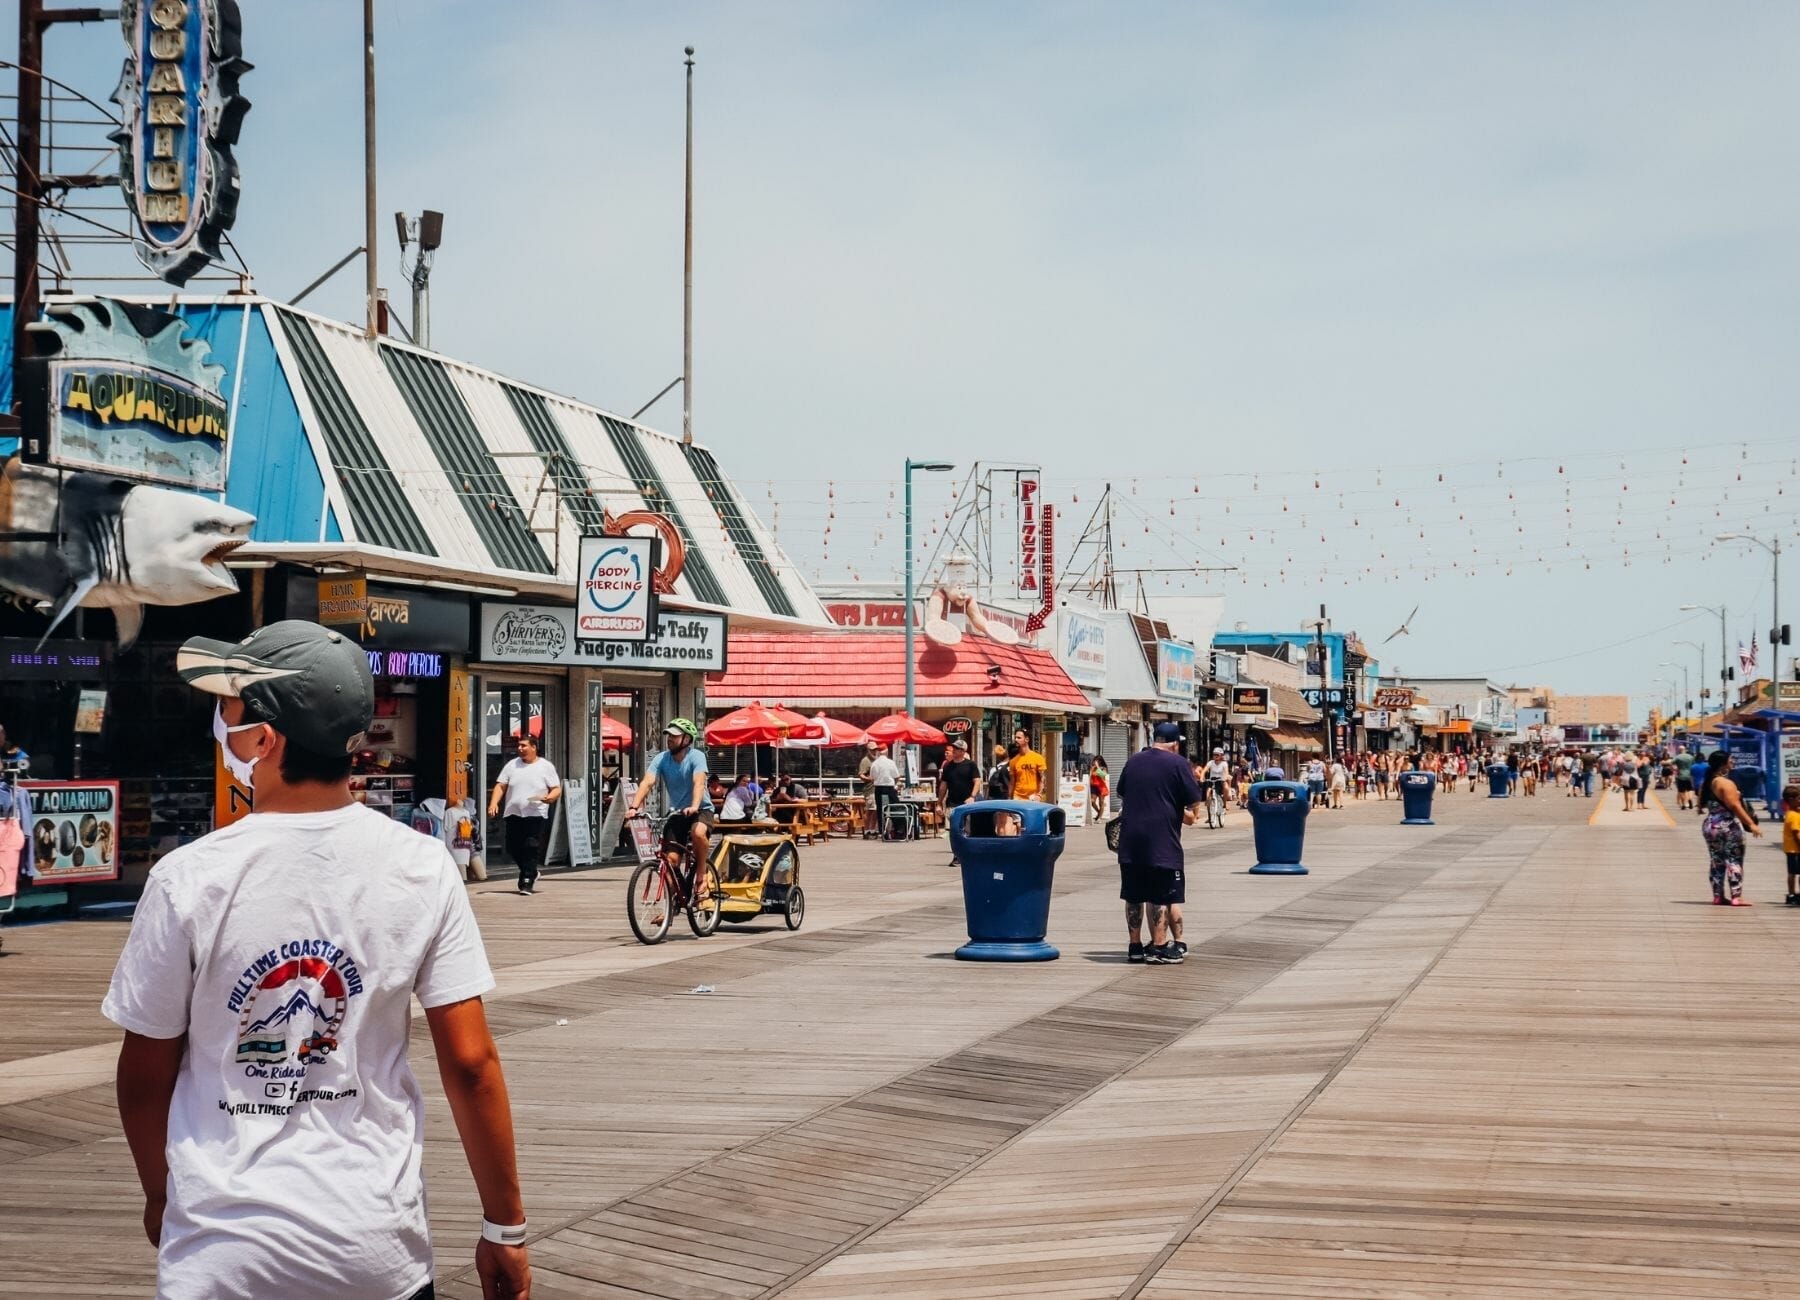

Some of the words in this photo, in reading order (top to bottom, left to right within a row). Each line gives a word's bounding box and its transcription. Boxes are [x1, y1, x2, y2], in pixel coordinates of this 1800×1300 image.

[66, 371, 228, 441] AQUARIUM
[1021, 479, 1038, 591] PIZZA
[598, 567, 630, 577] BODY
[331, 584, 354, 597] HAIR
[586, 581, 643, 591] PIERCING
[320, 599, 366, 614] BRAIDING
[582, 616, 643, 630] AIRBRUSH
[668, 621, 709, 643] Taffy
[388, 652, 408, 676] BODY
[1377, 695, 1410, 706] PIZZA
[944, 720, 970, 733] OPEN
[42, 791, 109, 813] AQUARIUM
[281, 939, 344, 970] COASTER
[343, 957, 364, 997] TOUR
[245, 1064, 269, 1078] One
[270, 1066, 296, 1079] Ride
